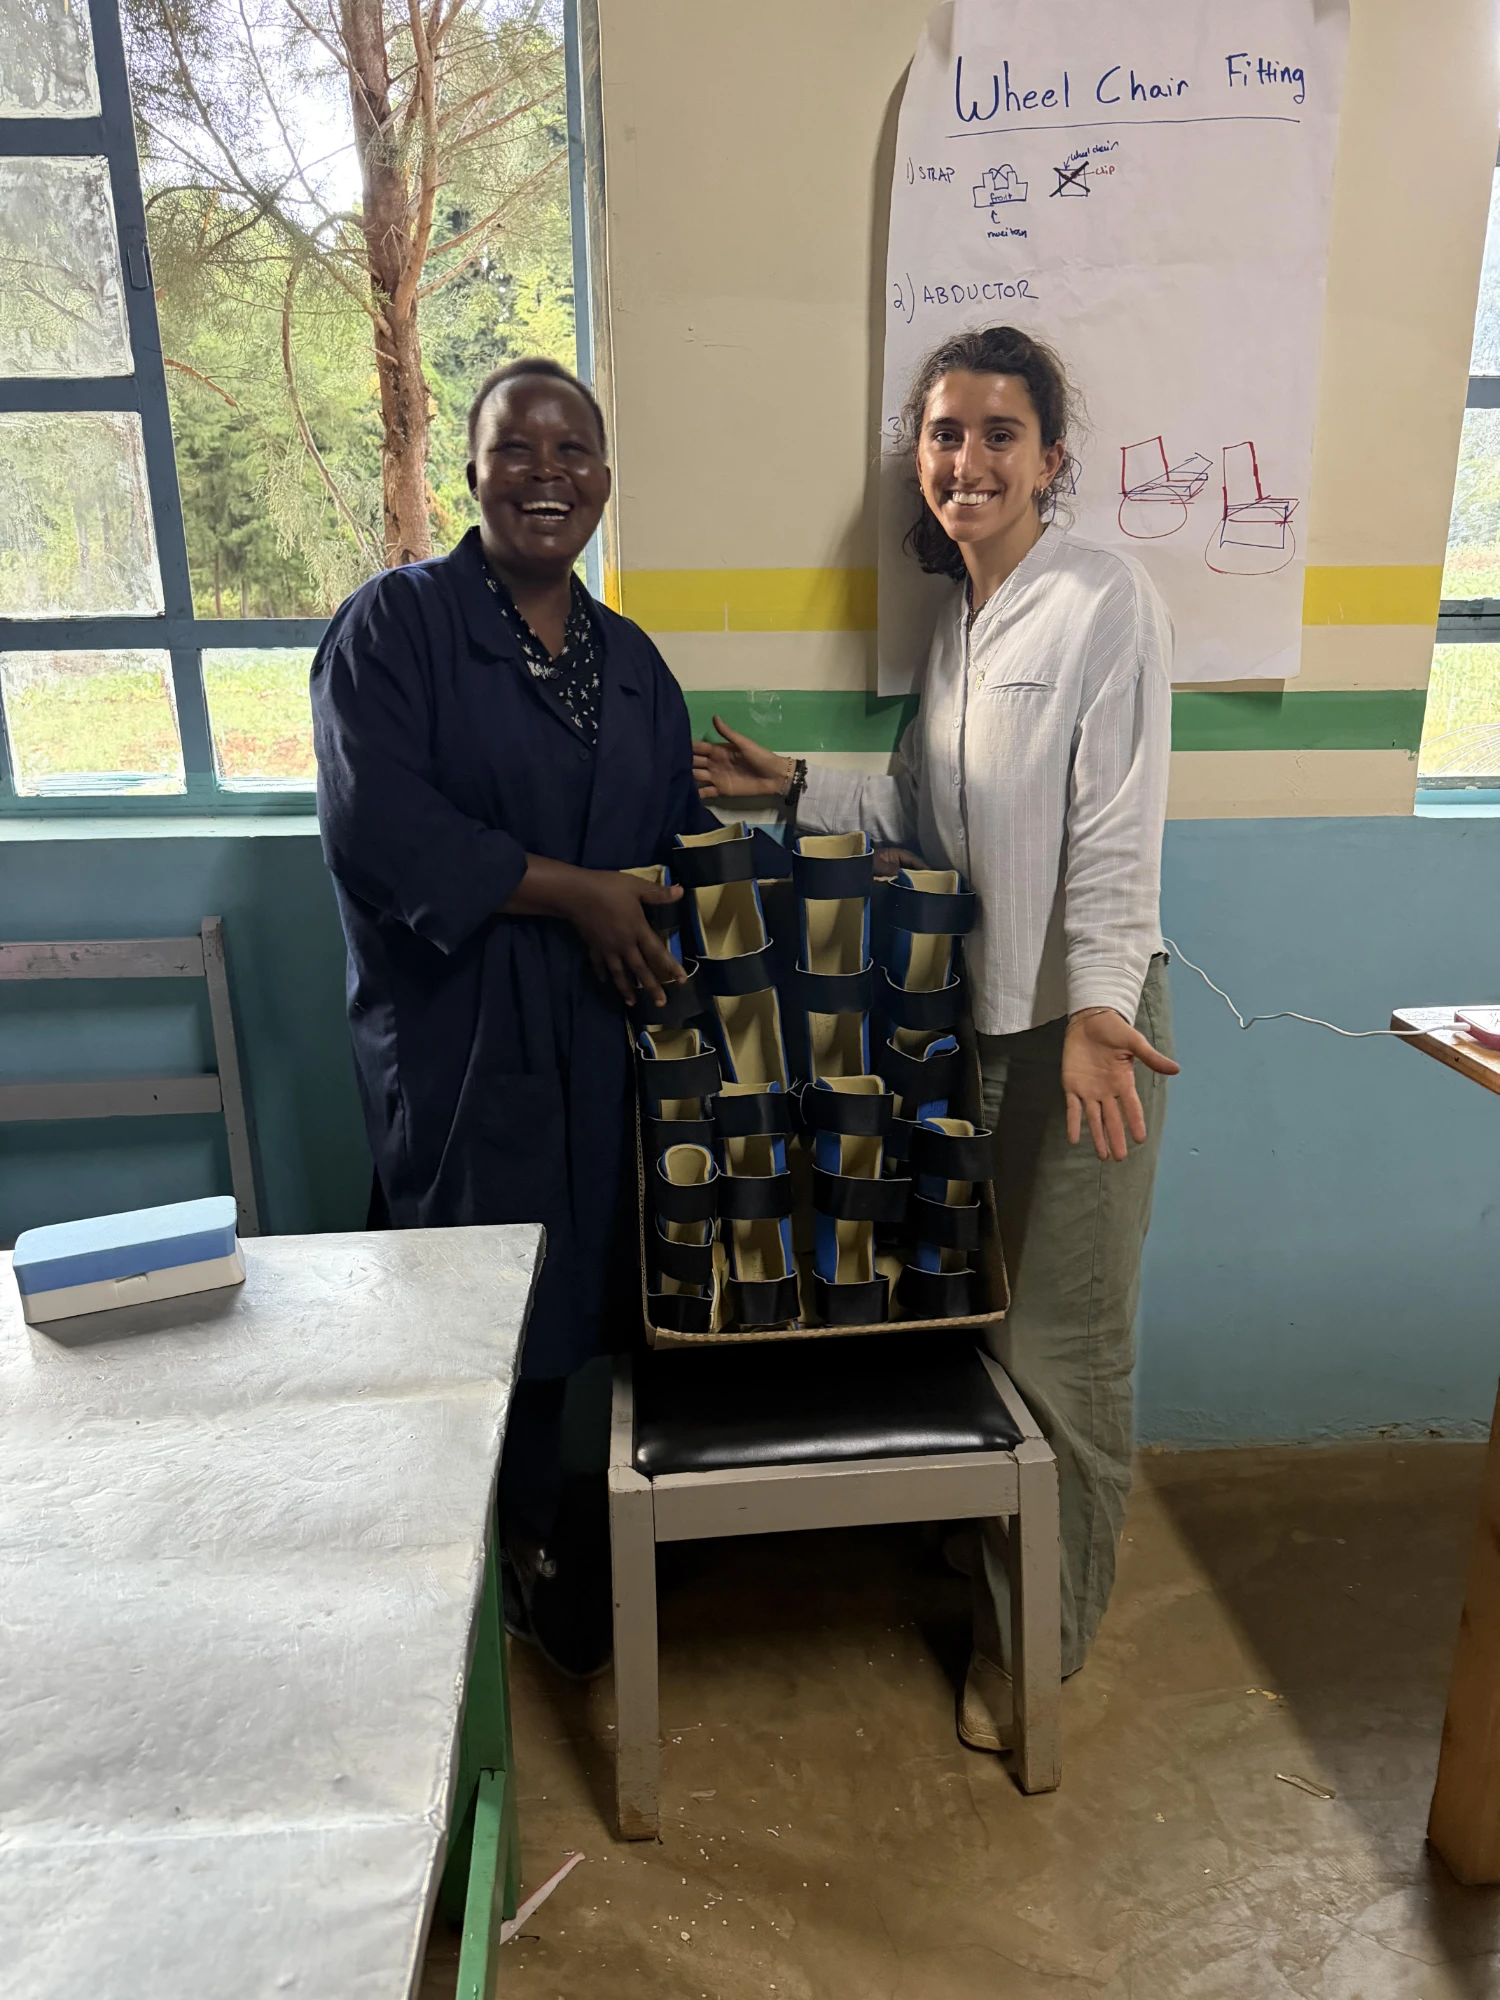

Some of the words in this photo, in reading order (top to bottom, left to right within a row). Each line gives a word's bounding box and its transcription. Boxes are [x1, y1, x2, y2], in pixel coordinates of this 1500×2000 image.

[955, 56, 1070, 123] Wheel
[1096, 66, 1189, 104] Chair
[1225, 53, 1306, 105] Fitting
[918, 166, 956, 184] STRAP
[923, 279, 1039, 304] ABDUCTOR
